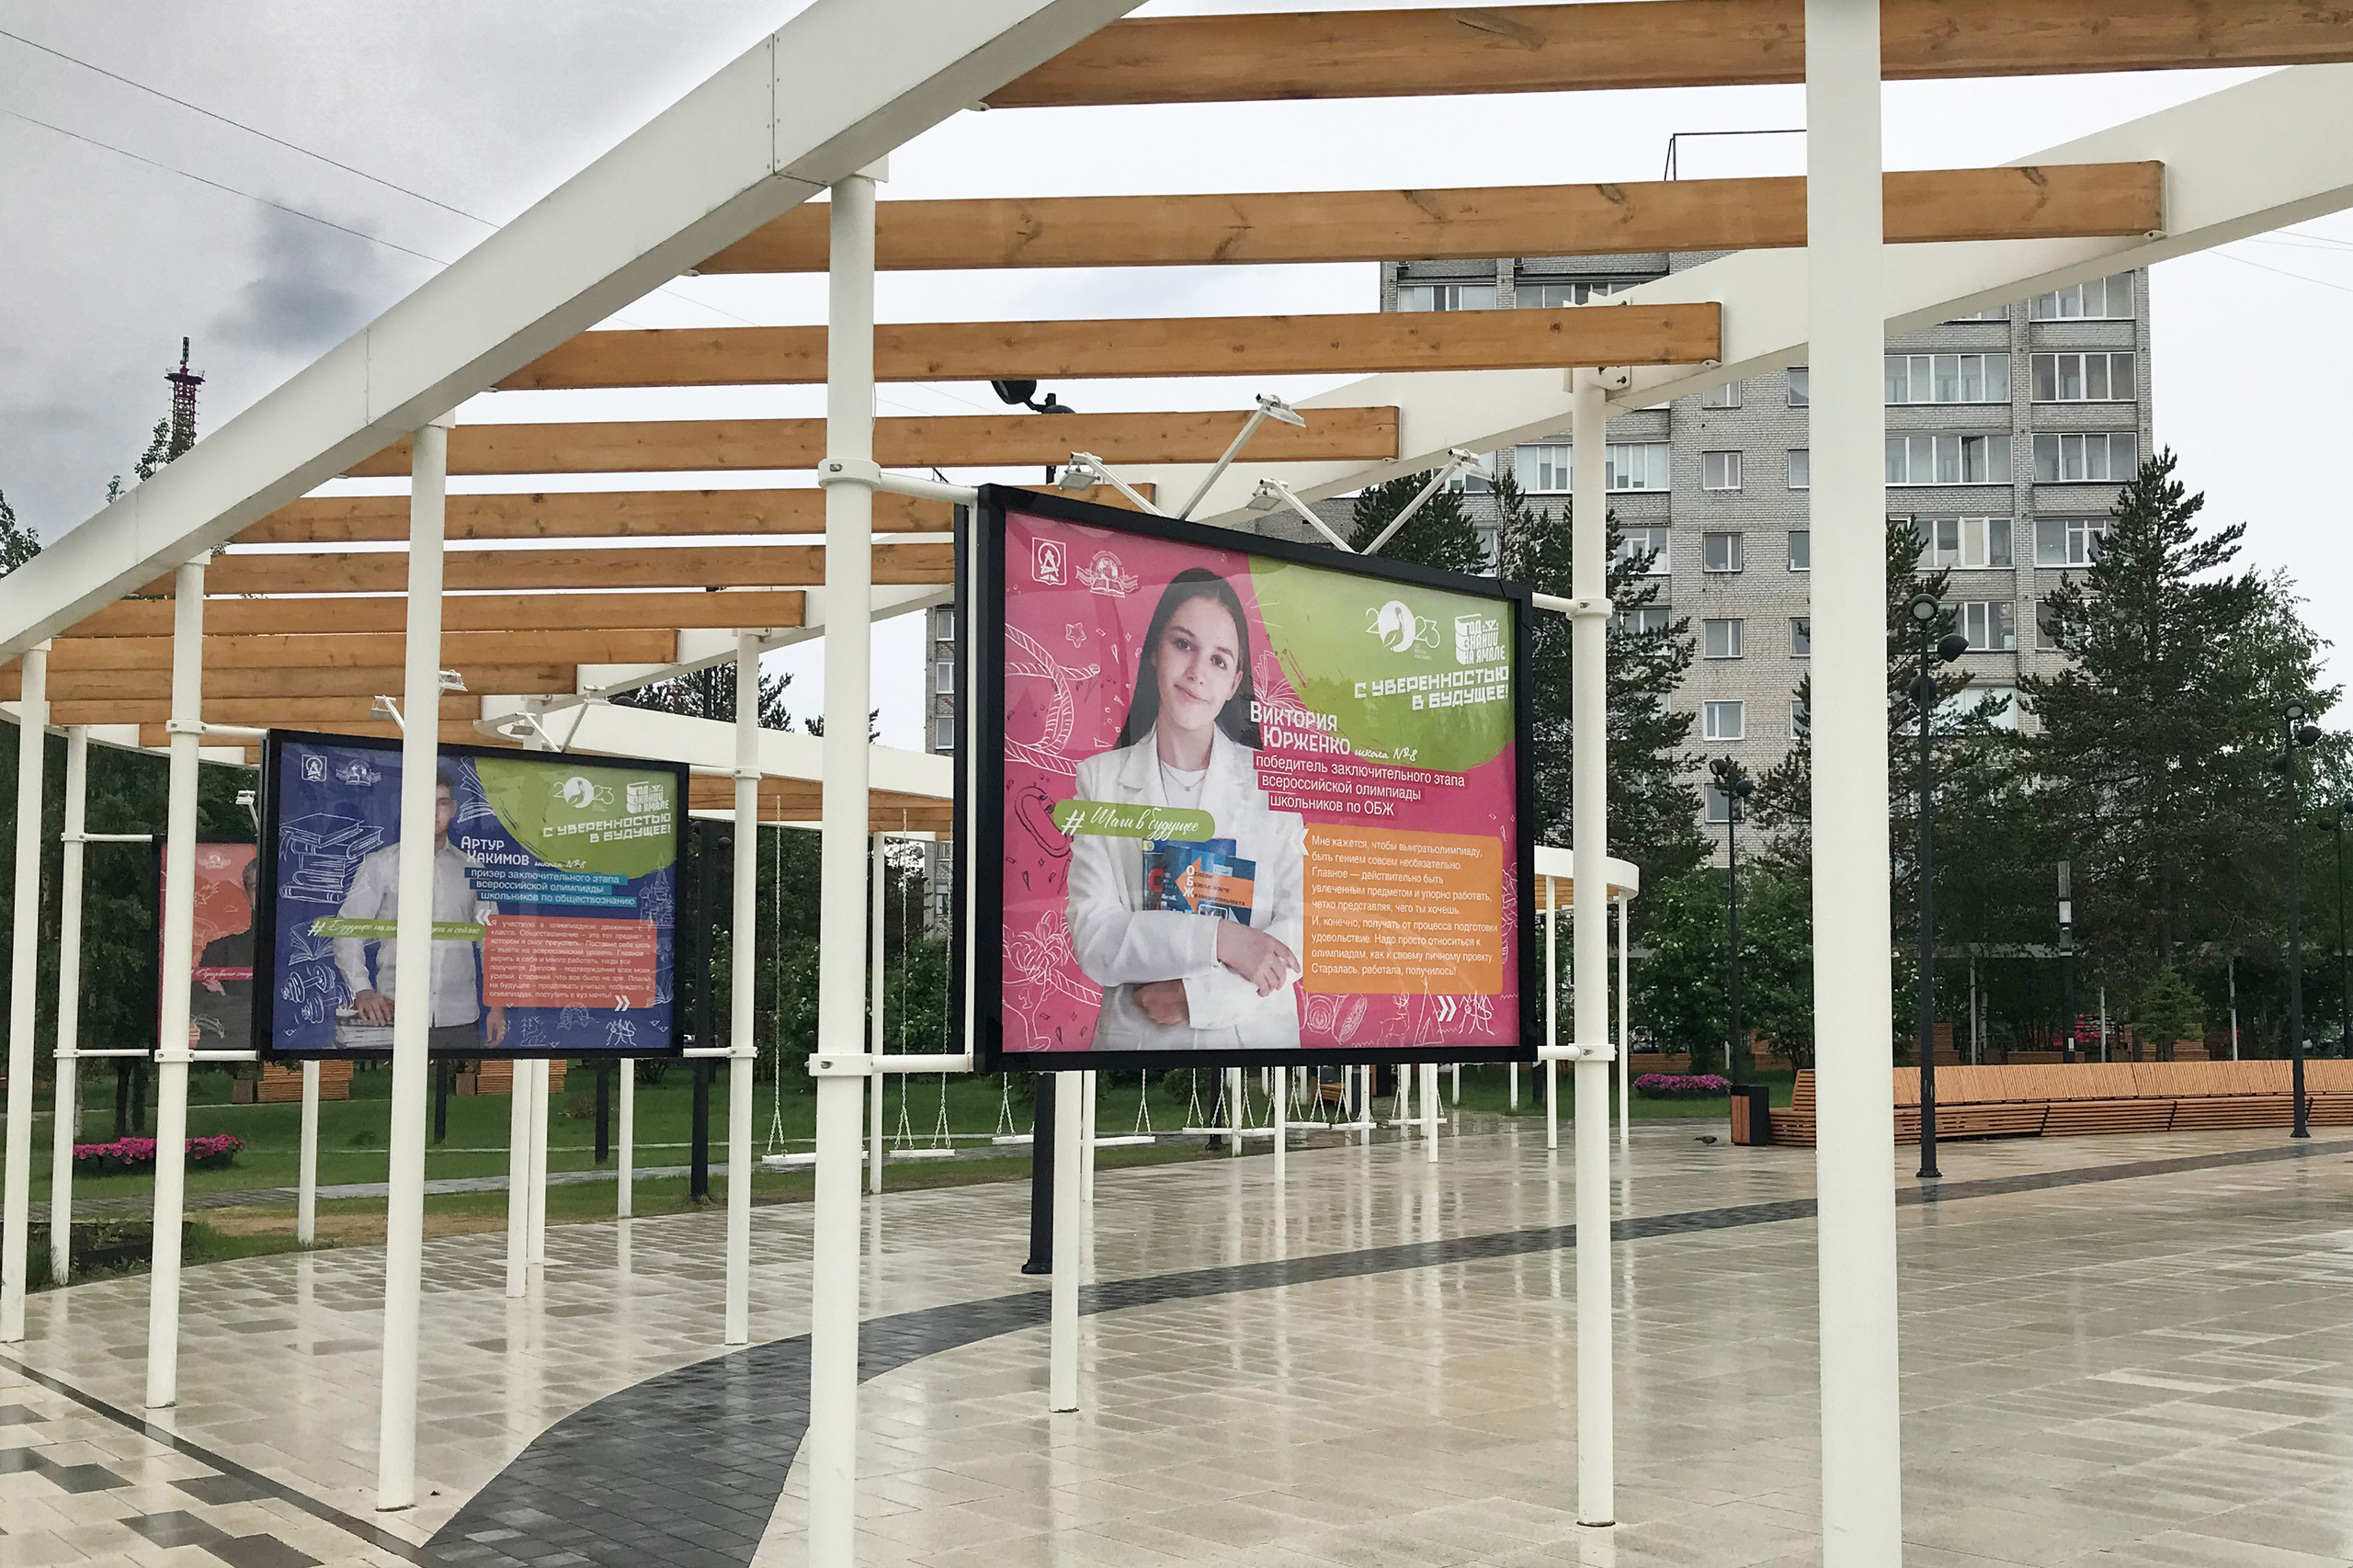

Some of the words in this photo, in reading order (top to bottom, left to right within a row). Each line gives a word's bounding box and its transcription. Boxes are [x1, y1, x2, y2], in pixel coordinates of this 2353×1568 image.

[1476, 645, 1506, 663] ЯМАЛЕ
[1355, 682, 1367, 699] С
[1372, 665, 1509, 697] УВЕРЕННОСТЬЮ
[1412, 695, 1424, 710] В
[1429, 684, 1509, 709] БУДУЩЕЕ!
[1355, 747, 1390, 759] школа
[1256, 755, 1328, 773] победитель
[1331, 764, 1431, 784] заключительного
[1434, 773, 1465, 788] этапа
[1262, 775, 1353, 794] всероссийской
[1356, 783, 1421, 801] олимпиады
[1270, 795, 1343, 812] школьников
[1347, 802, 1361, 813] по
[1364, 800, 1395, 816] ОБЖ
[543, 827, 553, 837] С
[557, 812, 672, 835] УВЕРЕННОСТЬЮ
[1148, 807, 1199, 841] будущее
[589, 833, 599, 844] В
[604, 824, 671, 842] БУДУЩЕЕ!
[1312, 835, 1331, 846] Мне
[1332, 838, 1370, 850] кажется,
[1372, 840, 1397, 851] чтобы
[1312, 851, 1333, 862] быть
[1336, 854, 1366, 864] гением
[1368, 857, 1397, 866] совсем
[471, 869, 506, 880] призер
[508, 870, 591, 883] заключительного
[592, 875, 620, 884] этапа
[1312, 867, 1348, 879] Главное
[1361, 870, 1421, 883] действительно
[1423, 874, 1444, 884] быть
[476, 881, 548, 891] всероссийской
[551, 884, 604, 894] олимпиады
[1312, 884, 1365, 895] увлеченным
[1368, 887, 1413, 898] предметом
[1415, 890, 1420, 898] и
[1421, 891, 1450, 901] упорно
[1453, 891, 1492, 902] работать,
[481, 892, 539, 902] школьников
[555, 894, 635, 906] обществознанию
[1312, 900, 1336, 909] четко
[1337, 901, 1393, 913] представляя,
[1395, 903, 1414, 913] чего
[1415, 905, 1426, 914] ты
[1427, 905, 1461, 915] хочешь.
[1324, 918, 1360, 928] конечно,
[1362, 920, 1400, 930] получать
[1402, 921, 1412, 929] от
[1414, 921, 1452, 932] процесса
[1454, 923, 1498, 933] подготовки
[1374, 934, 1396, 945] Надо
[1398, 937, 1427, 947] просто
[1428, 937, 1474, 947] относиться
[1312, 949, 1369, 960] олимпиадам,
[1370, 950, 1385, 960] как
[1392, 952, 1423, 962] своему
[1426, 953, 1461, 963] личному
[1362, 964, 1404, 976] работала,
[1405, 966, 1457, 978] получилось!
